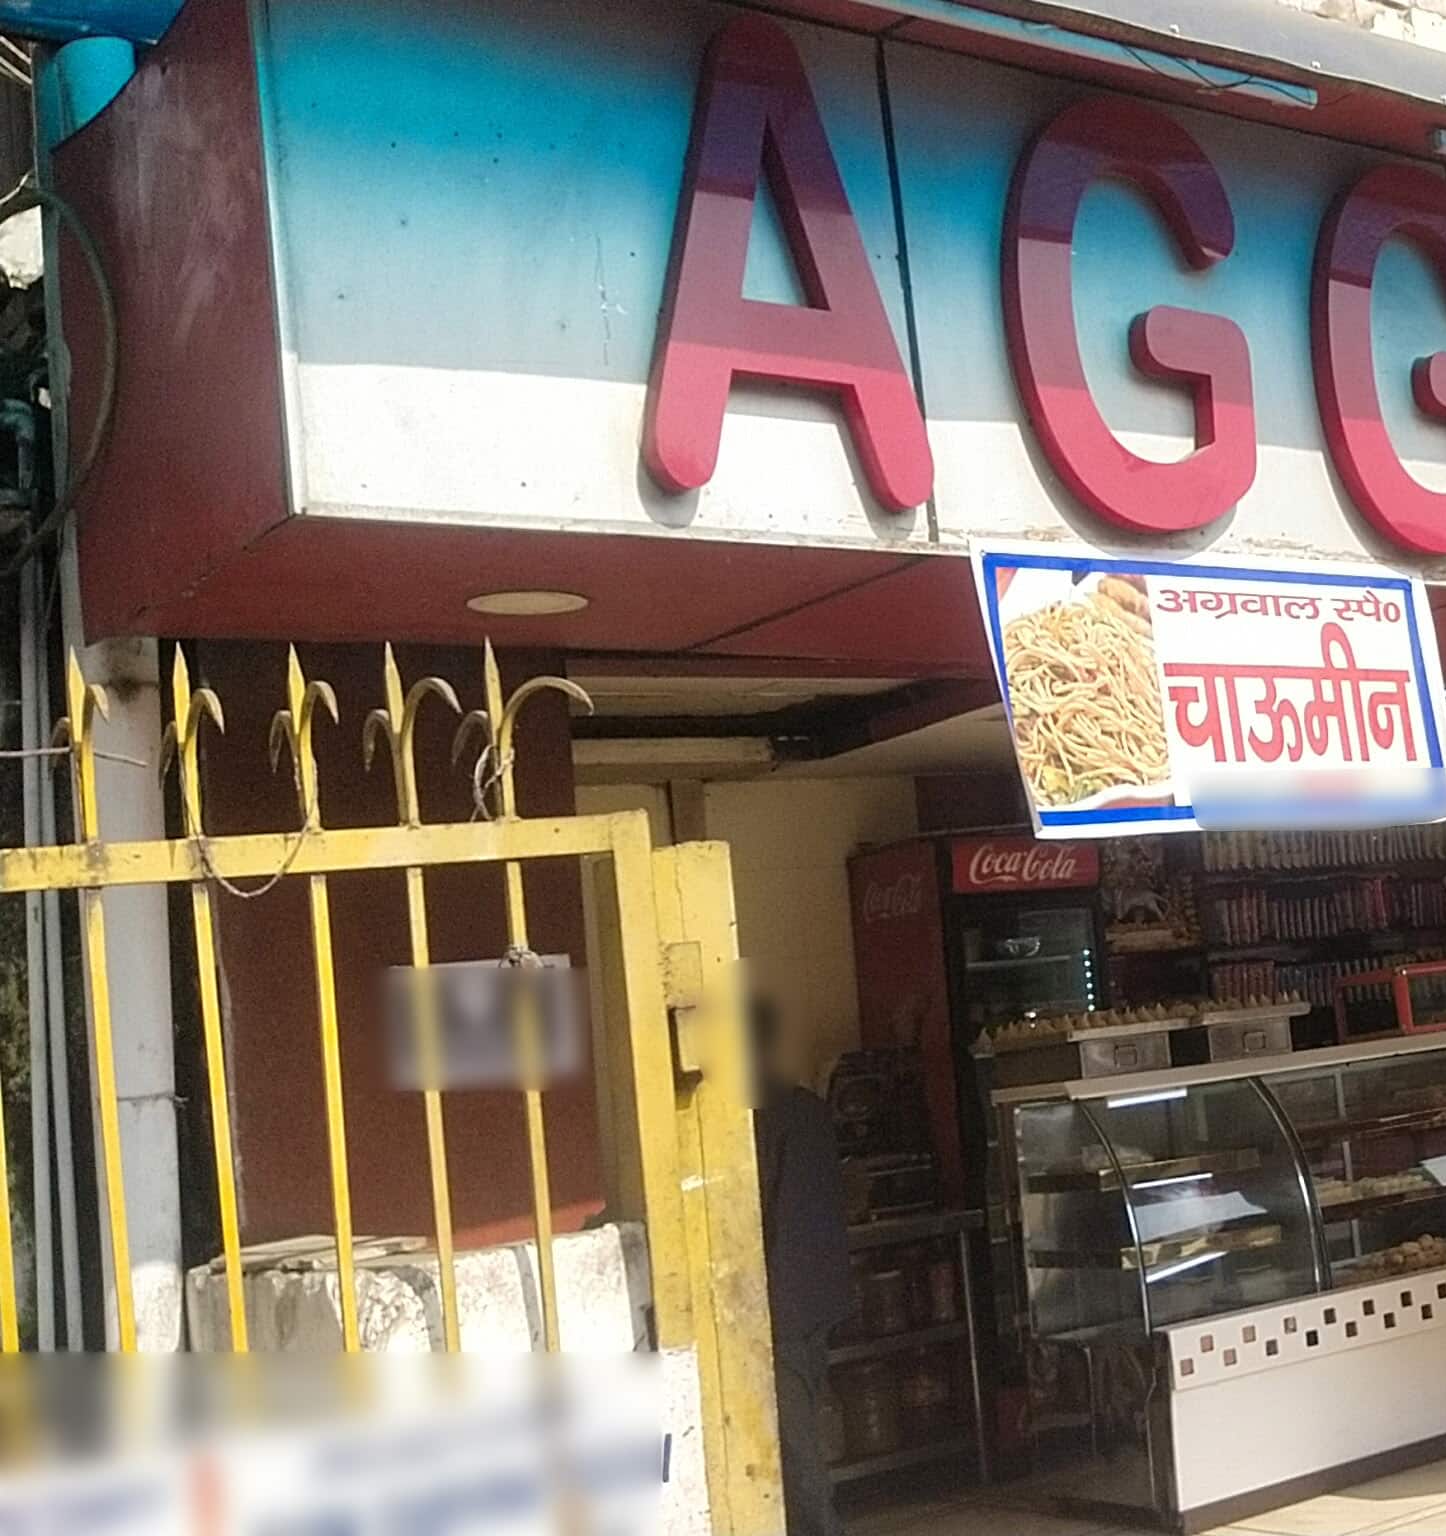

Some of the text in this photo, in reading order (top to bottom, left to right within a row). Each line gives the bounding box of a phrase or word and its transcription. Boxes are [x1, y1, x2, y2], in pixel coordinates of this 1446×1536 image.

[1157, 588, 1321, 619] अग्रवाल
[1163, 622, 1418, 763] चाऊमीन
[969, 843, 1076, 884] Coca-Cola
